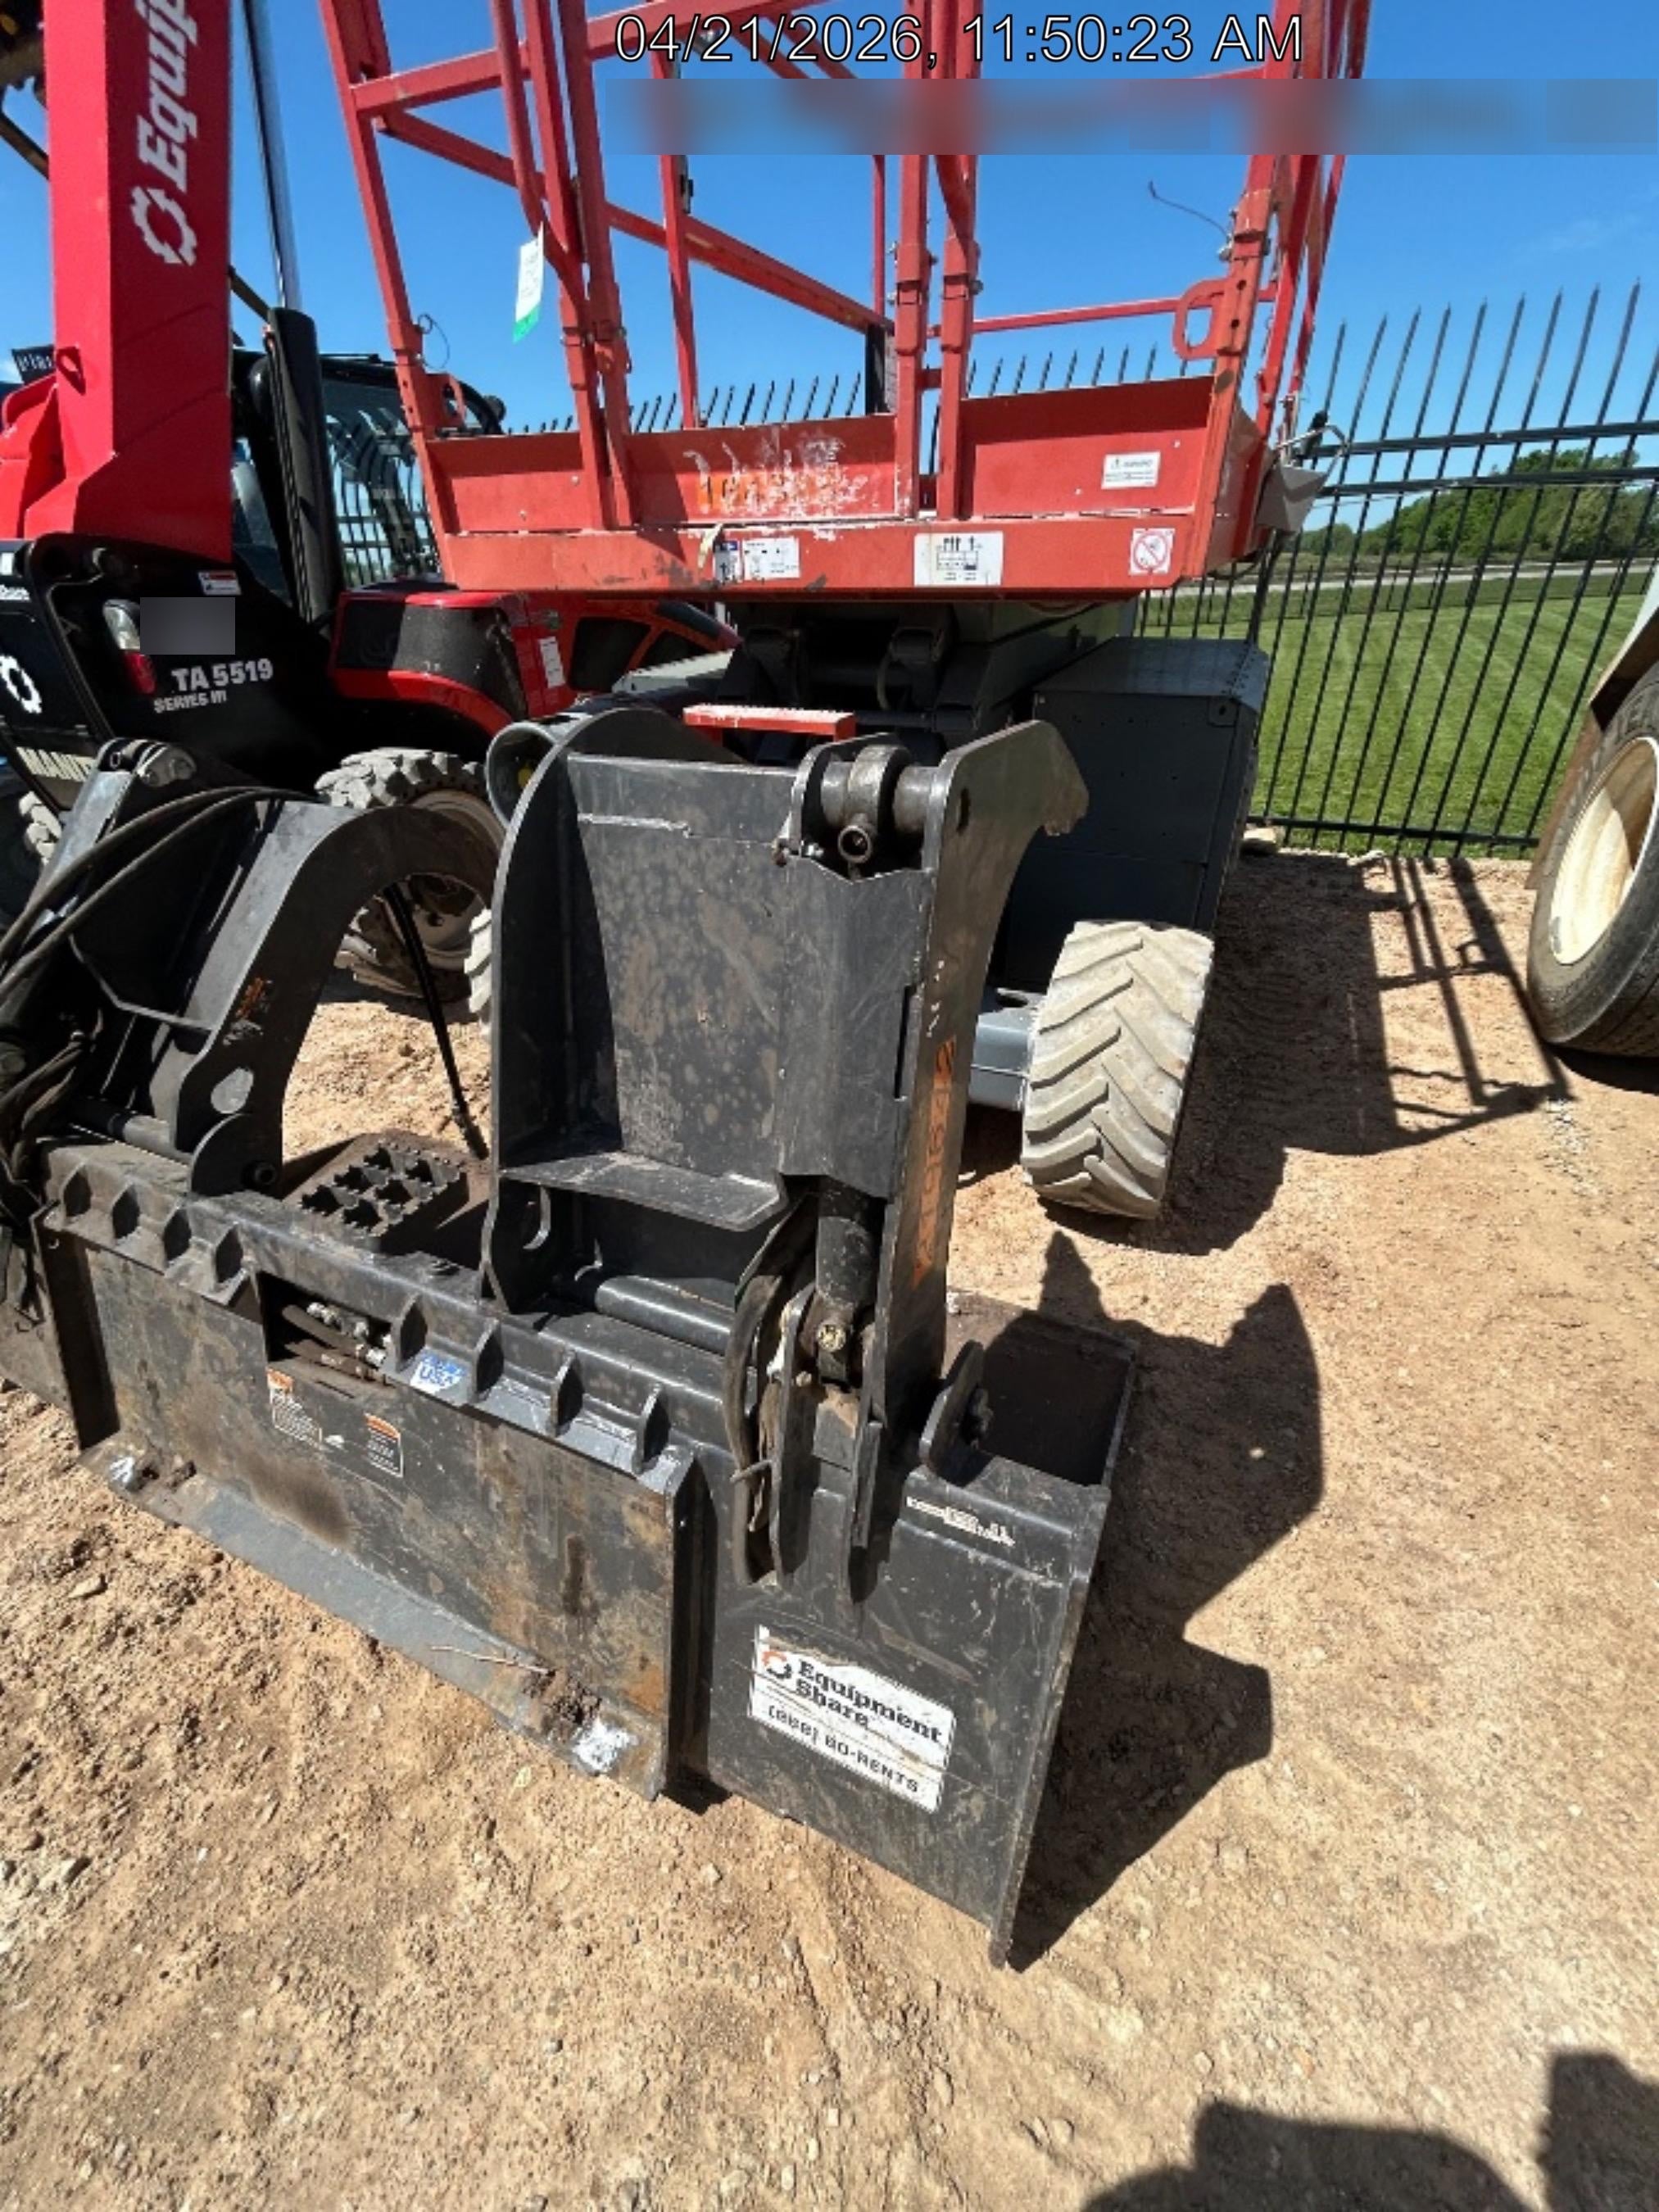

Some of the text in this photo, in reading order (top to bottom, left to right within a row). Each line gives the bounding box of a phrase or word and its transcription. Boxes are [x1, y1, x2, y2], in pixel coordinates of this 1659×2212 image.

[170, 658, 274, 691] TA 5519
[153, 693, 210, 714] SERIES
[796, 1678, 869, 1730] Share
[798, 1660, 943, 1743] Equipment
